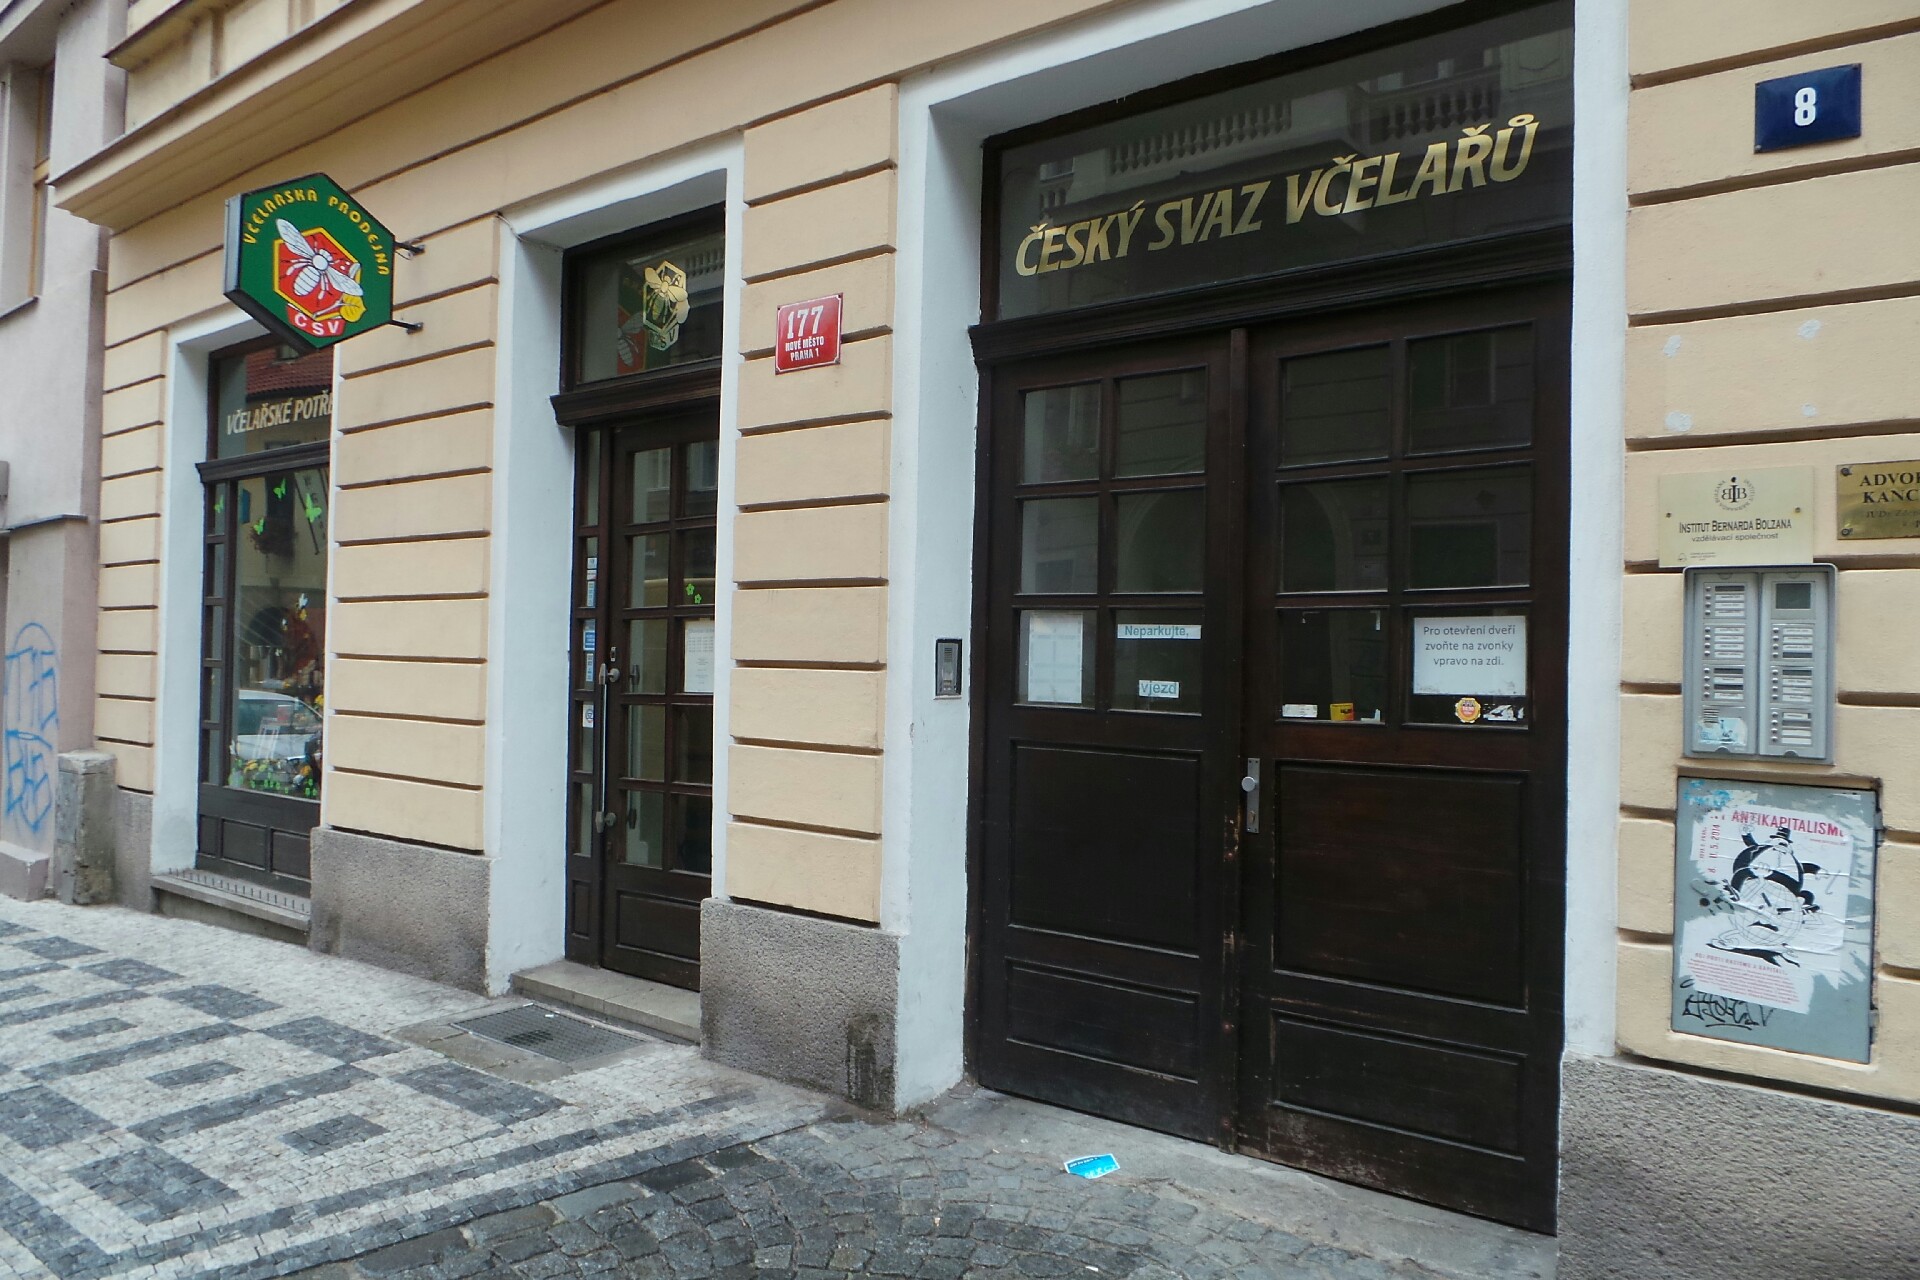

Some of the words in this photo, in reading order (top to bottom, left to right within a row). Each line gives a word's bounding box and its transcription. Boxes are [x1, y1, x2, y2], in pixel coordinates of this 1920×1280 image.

[1794, 87, 1816, 126] 8
[1015, 200, 1145, 277] ČESKÝ
[1147, 180, 1270, 251] SVAZ
[1284, 113, 1540, 224] VČELAŘŮ
[327, 195, 390, 275] PRODEJNA
[787, 305, 824, 340] 177
[785, 337, 802, 352] NOVÉ
[802, 335, 825, 349] MĚSTO
[790, 348, 814, 362] PRAHA
[814, 347, 819, 357] 1
[227, 397, 293, 435] VČELAŘSKÉ
[1124, 625, 1189, 639] Neparkujte,
[1423, 626, 1440, 636] Pro
[1443, 625, 1486, 636] otevření
[1488, 624, 1516, 635] dveří
[1425, 641, 1459, 651] zvoňte
[1462, 642, 1474, 651] na
[1477, 640, 1514, 652] zvonky
[1433, 657, 1468, 667] vpravo
[1471, 657, 1484, 666] na
[1486, 655, 1504, 666] zdi.
[1140, 681, 1177, 696] vjezd
